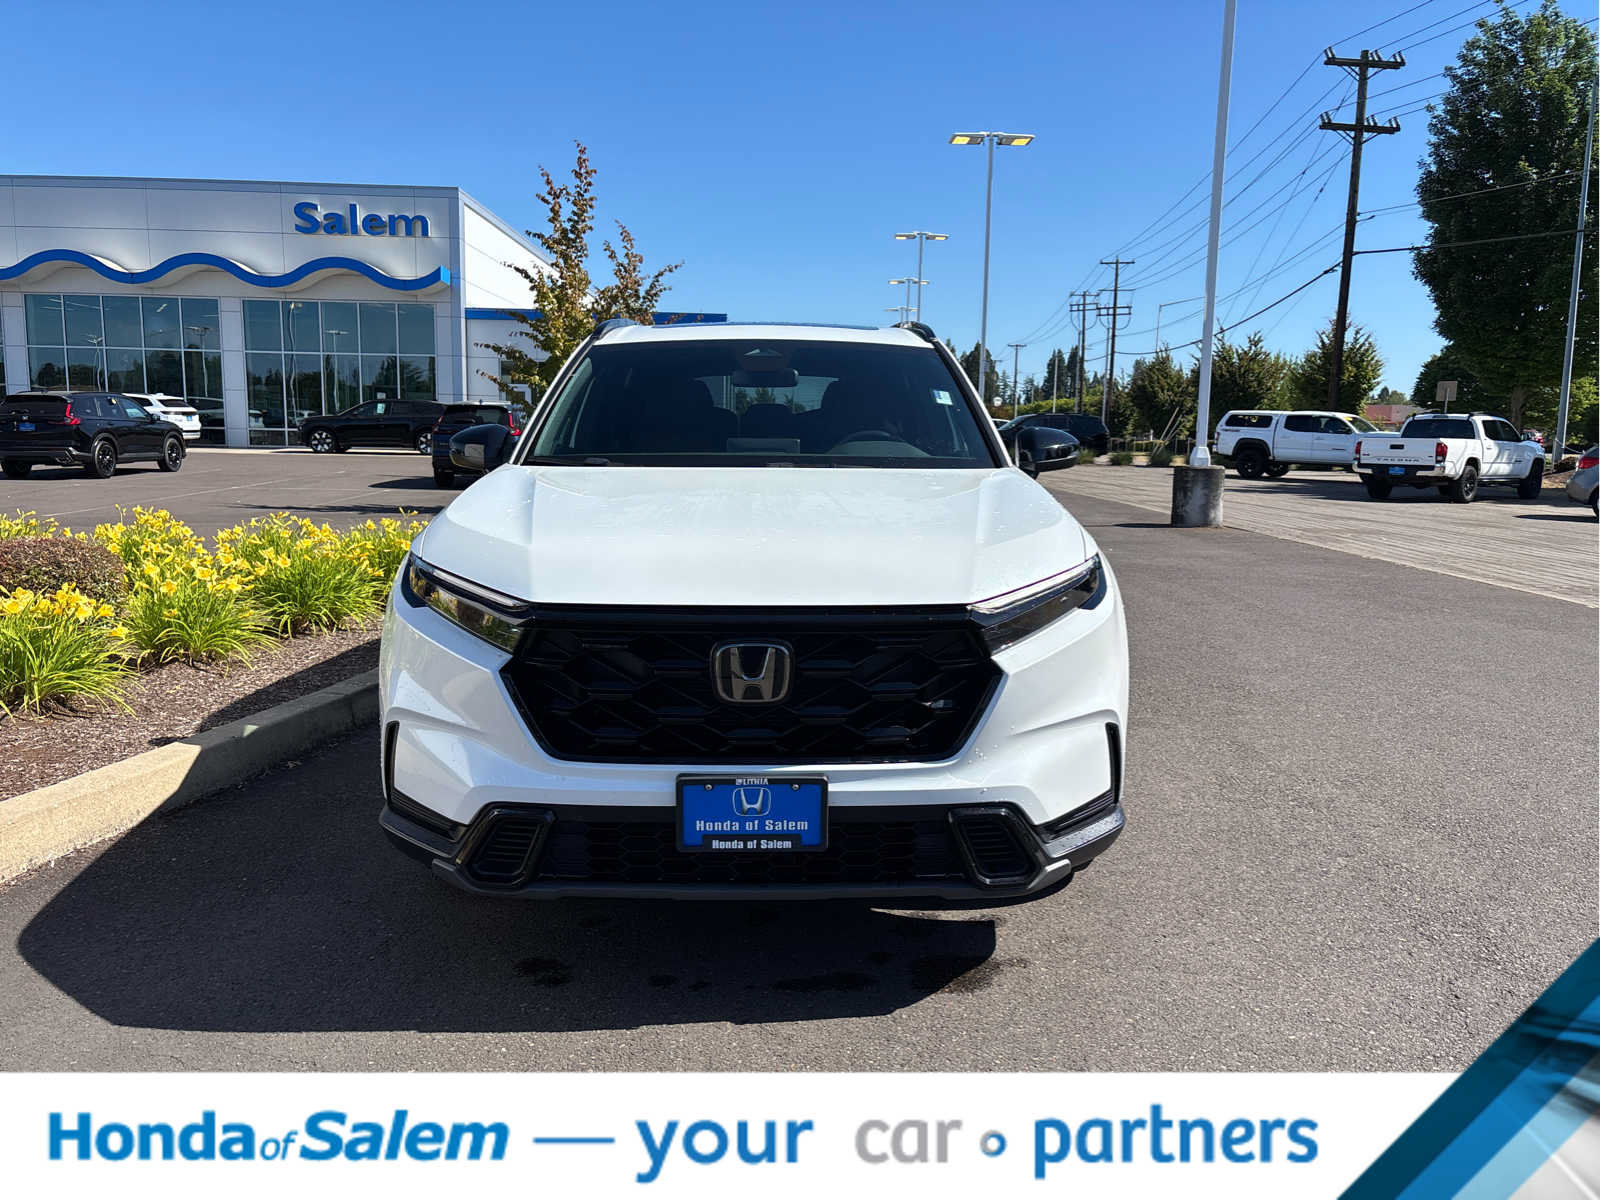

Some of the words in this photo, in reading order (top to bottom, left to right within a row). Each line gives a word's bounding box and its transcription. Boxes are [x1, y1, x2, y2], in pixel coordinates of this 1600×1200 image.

[294, 201, 430, 238] Salem
[696, 819, 740, 831] Honda
[745, 819, 759, 831] of
[765, 819, 809, 831] Salem
[712, 839, 744, 849] Honda
[747, 839, 757, 849] of
[760, 839, 792, 849] Salem
